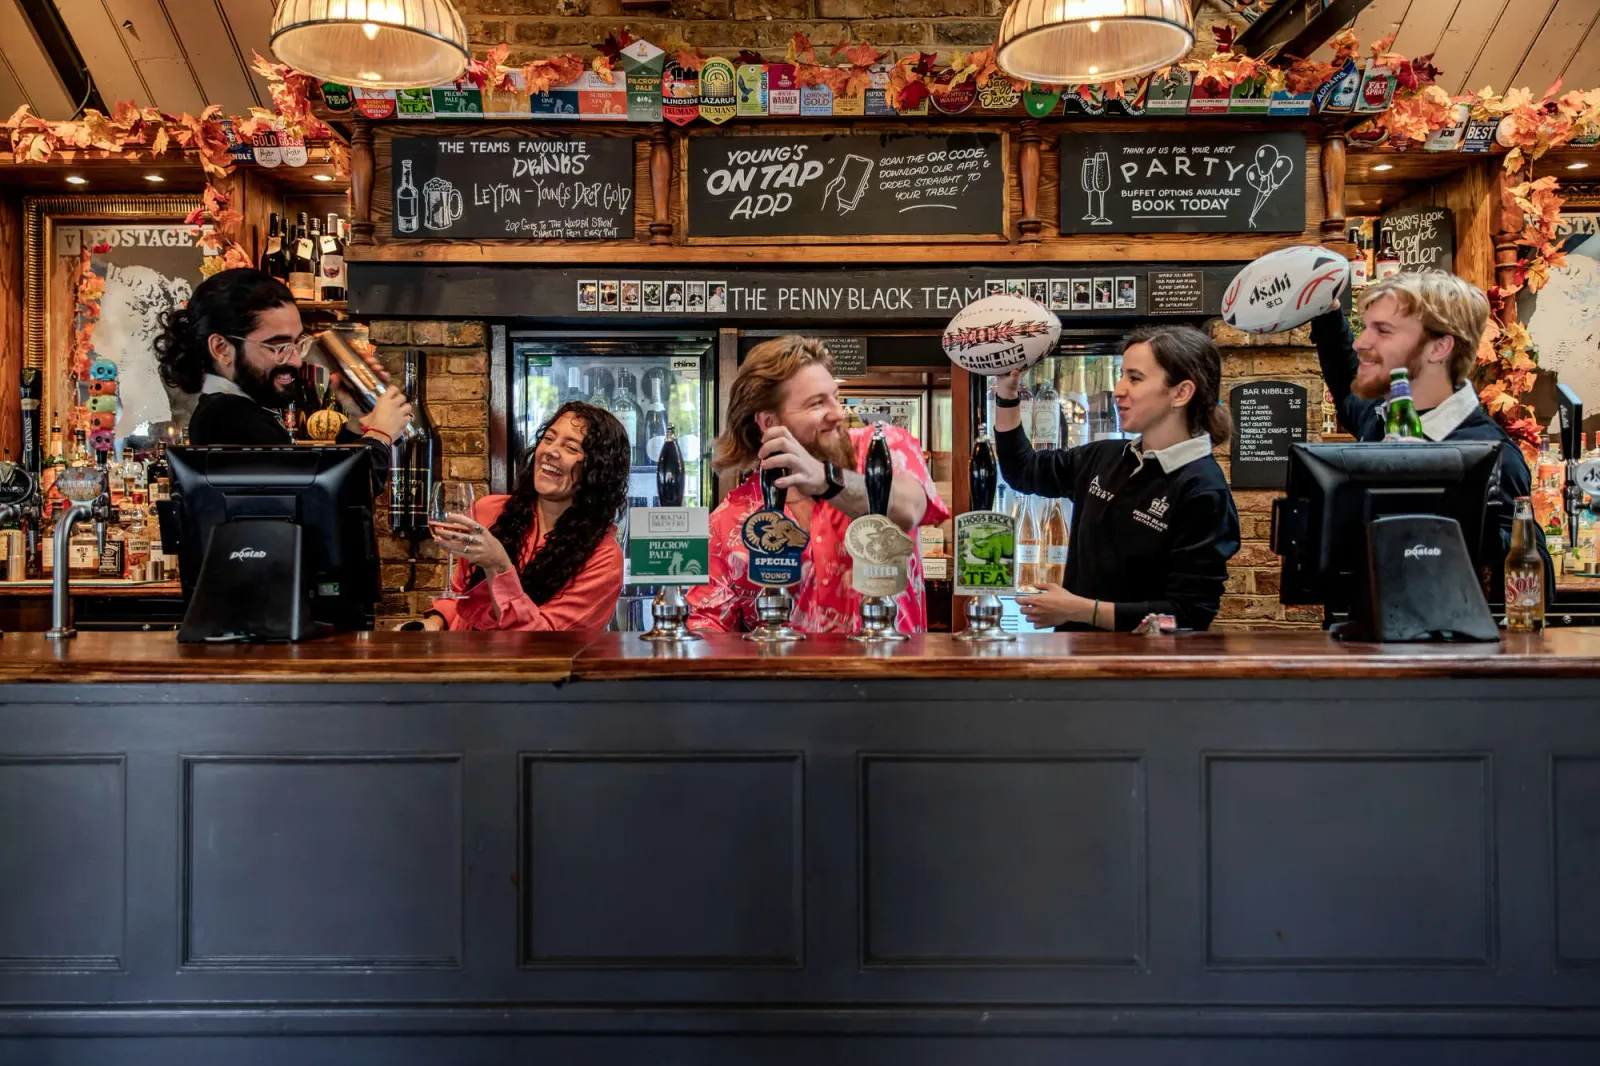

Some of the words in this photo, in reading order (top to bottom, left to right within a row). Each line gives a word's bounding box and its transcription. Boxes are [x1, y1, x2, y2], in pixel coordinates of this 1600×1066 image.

[1316, 71, 1347, 103] ADNAMS
[1369, 81, 1387, 89] FAT
[325, 94, 349, 105] TEA
[662, 97, 699, 105] BLINDSIDE
[700, 96, 736, 104] LAZARUS
[772, 96, 798, 105] WARMER
[803, 98, 830, 106] GOLD
[980, 90, 1016, 107] Dance
[402, 103, 429, 112] TEA
[664, 107, 699, 115] TRUMAN'S
[701, 106, 736, 114] TRUMAN'S
[1440, 129, 1456, 138] JOB
[1467, 127, 1496, 140] BEST
[252, 134, 278, 147] GOLD
[439, 142, 465, 153] THE
[470, 142, 510, 153] TEAMS
[518, 141, 586, 153] FAVOURITE
[727, 145, 808, 166] YOUNG'S
[879, 155, 905, 167] SCAN
[906, 154, 926, 164] THE
[926, 150, 947, 162] QR
[948, 147, 988, 161] CODE,
[1122, 146, 1144, 155] THINK
[1146, 146, 1157, 154] OF
[1158, 146, 1169, 154] US
[1172, 146, 1188, 154] FOR
[1191, 146, 1210, 154] YOUR
[1214, 146, 1236, 154] NEXT
[879, 165, 929, 179] DOWNLOAD
[931, 163, 954, 174] OUR
[956, 160, 980, 171] APP,
[982, 159, 992, 168] &
[1120, 156, 1245, 183] PARTY
[879, 179, 911, 190] ORDER
[914, 173, 963, 188] STRAIGHT
[967, 172, 982, 182] TO
[474, 183, 521, 213] LEYTON
[895, 190, 921, 201] YOUR
[925, 186, 959, 197] TABLE
[1121, 189, 1156, 197] BUFFET
[1158, 188, 1193, 197] OPTIONS
[1196, 188, 1242, 197] AVAILABLE
[730, 192, 793, 220] APP
[1132, 199, 1175, 212] BOOK
[1180, 198, 1229, 211] TODAY
[548, 219, 562, 228] THE
[1383, 214, 1419, 227] ALWAYS
[1420, 210, 1445, 221] LOOK
[1396, 223, 1411, 232] ON
[1412, 219, 1433, 229] THE
[64, 234, 76, 249] V
[90, 228, 193, 248] POSTAGE
[1391, 227, 1438, 253] bright
[1249, 272, 1292, 306] Asahi
[729, 287, 767, 311] THE
[778, 287, 844, 311] PENNY
[847, 286, 913, 310] BLACK
[921, 286, 983, 310] TEAM
[959, 343, 1027, 370] GAINLINE
[673, 360, 697, 368] rhino
[1559, 404, 1570, 430] Asahi
[25, 416, 33, 452] GUINNESS
[963, 513, 987, 525] HOGS
[987, 513, 1009, 525] BACK
[1132, 509, 1151, 521] PENNY
[648, 541, 690, 550] PILCROW
[1404, 544, 1442, 560] poslab
[229, 548, 267, 562] poslab
[648, 550, 673, 559] PALE
[754, 557, 798, 567] SPECIAL
[760, 571, 792, 580] YOUNG'S
[965, 571, 1007, 585] TEA
[1504, 575, 1538, 605] SOL
